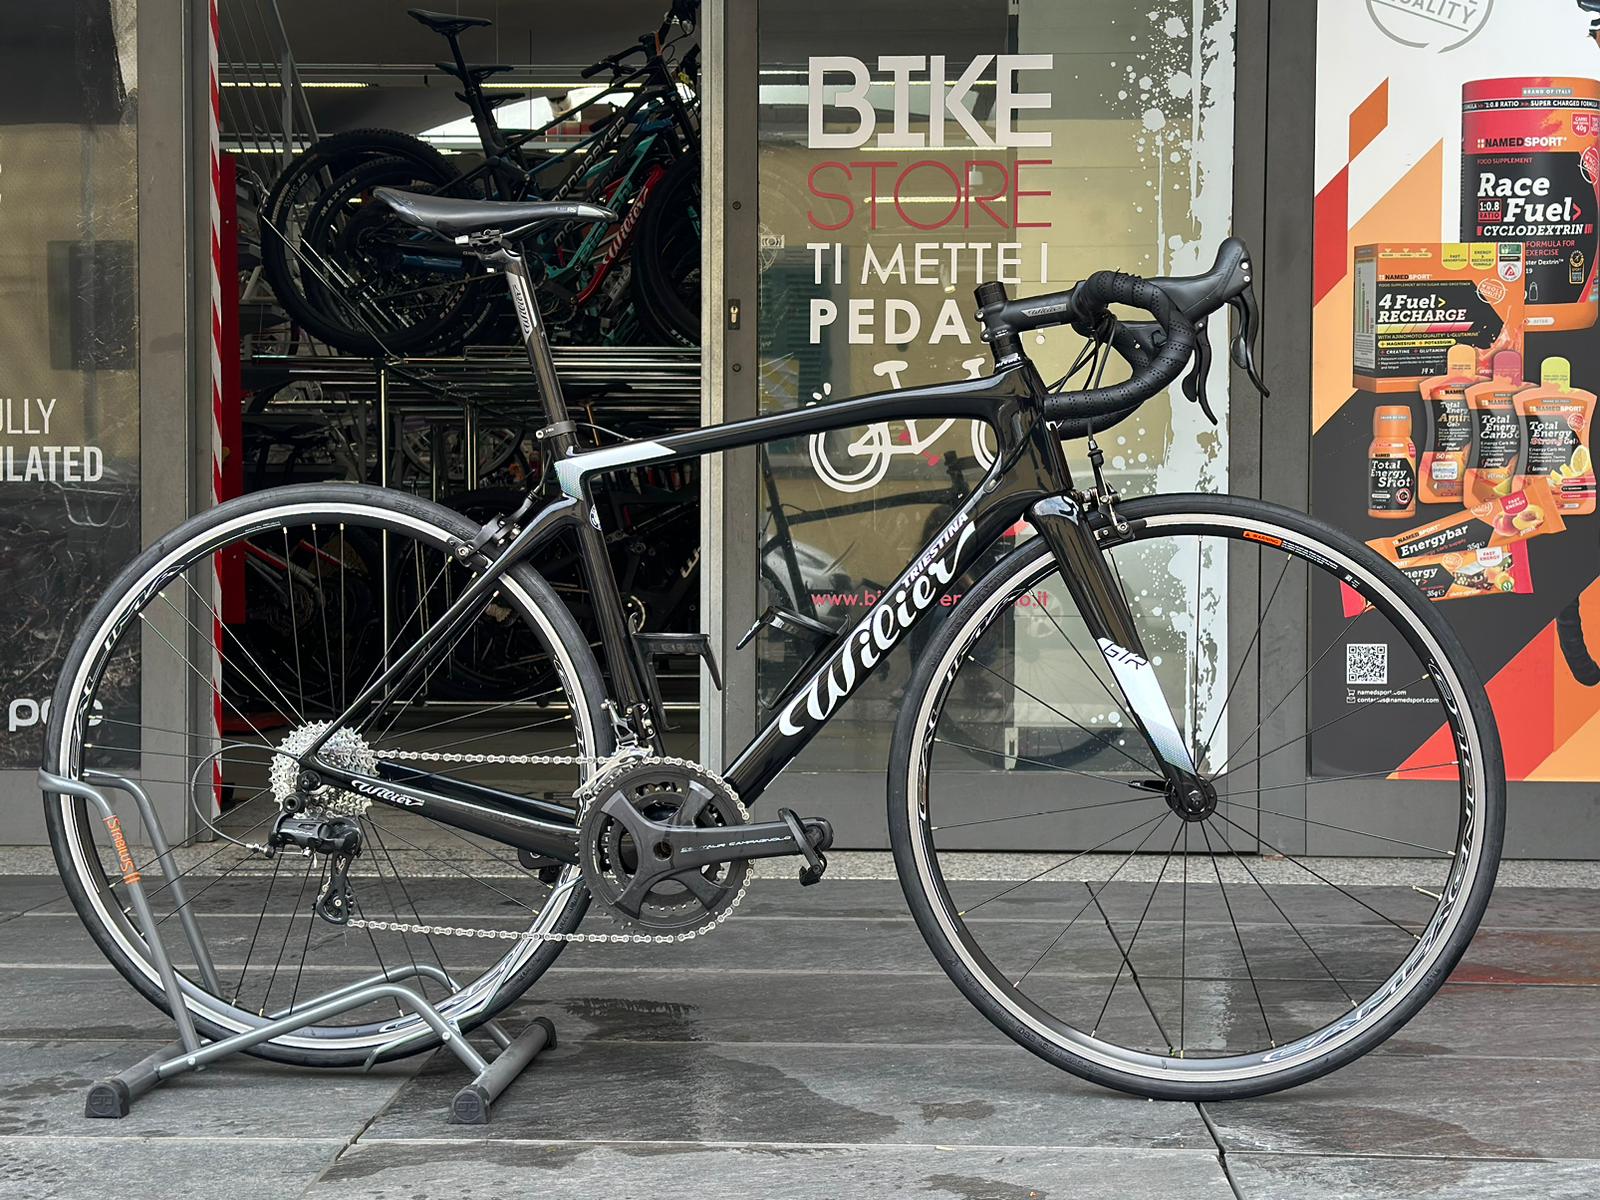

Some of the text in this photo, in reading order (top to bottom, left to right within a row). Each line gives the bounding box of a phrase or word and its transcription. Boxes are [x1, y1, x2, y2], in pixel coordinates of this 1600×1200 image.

[1392, 0, 1476, 24] ALITY
[808, 54, 1053, 149] BIKE
[1485, 137, 1563, 147] NAMEDSPORT
[1477, 173, 1550, 197] Race
[807, 160, 1052, 230] STORE
[1479, 201, 1500, 211] 1:0.8
[1503, 197, 1573, 222] Fuel
[1483, 223, 1584, 236] CYCLODEXTRIN
[1562, 239, 1575, 247] FOR
[1526, 249, 1559, 257] EXERCISE
[807, 243, 1048, 285] TI METTE I
[1378, 294, 1437, 309] 4 Fuel
[1378, 309, 1467, 322] RECHARGE
[0, 399, 57, 435] LLY
[1481, 415, 1510, 423] Total
[1529, 421, 1558, 430] Total
[1480, 431, 1514, 439] Carbo
[1532, 430, 1572, 440] Energy
[1372, 460, 1401, 469] Total
[1370, 470, 1407, 478] Energy
[1377, 477, 1411, 488] Shot
[1400, 524, 1469, 557] Energybar
[901, 512, 968, 588] TRIESTINA
[1401, 567, 1438, 581] nergy
[778, 520, 976, 736] Wilier
[351, 780, 425, 807] Wilier
